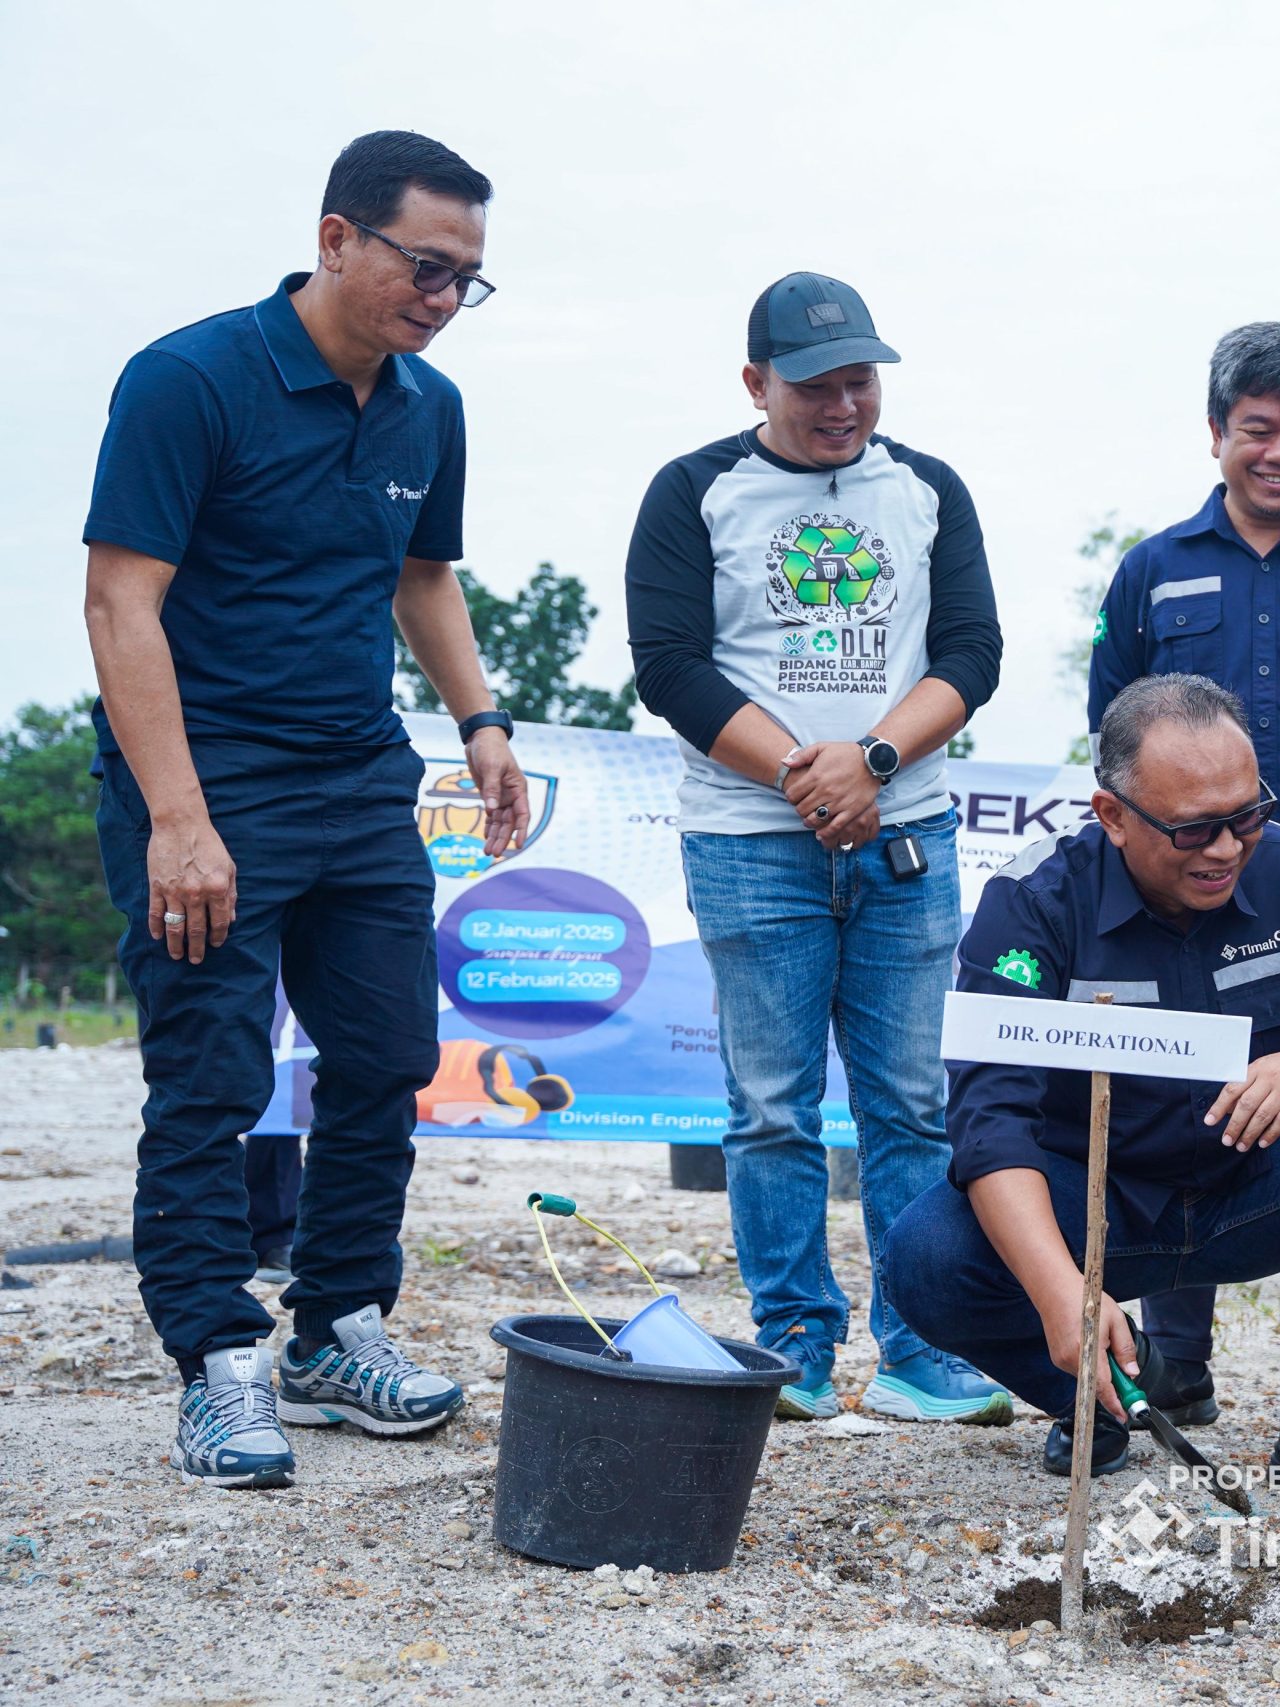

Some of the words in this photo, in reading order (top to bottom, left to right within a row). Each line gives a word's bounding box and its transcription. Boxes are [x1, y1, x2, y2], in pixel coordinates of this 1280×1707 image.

[841, 628, 887, 658] DLH
[779, 659, 837, 671] BIDANG
[842, 659, 859, 669] KAB.
[778, 671, 887, 683] PENGELOLAAN
[777, 682, 888, 695] PERSAMPAHAN
[472, 921, 491, 939] 12
[491, 922, 562, 940] Januari
[563, 924, 615, 941] 2025
[1238, 938, 1278, 956] Timah
[466, 971, 486, 989] 12
[487, 971, 565, 989] Februari
[567, 972, 620, 989] 2025
[671, 1039, 720, 1053] Pene
[997, 1023, 1040, 1043] DIR.
[1045, 1028, 1197, 1057] OPERATIONAL
[559, 1110, 645, 1126] Division
[651, 1112, 728, 1130] Engine
[360, 1312, 374, 1324] NIKE
[234, 1353, 253, 1361] NIKE
